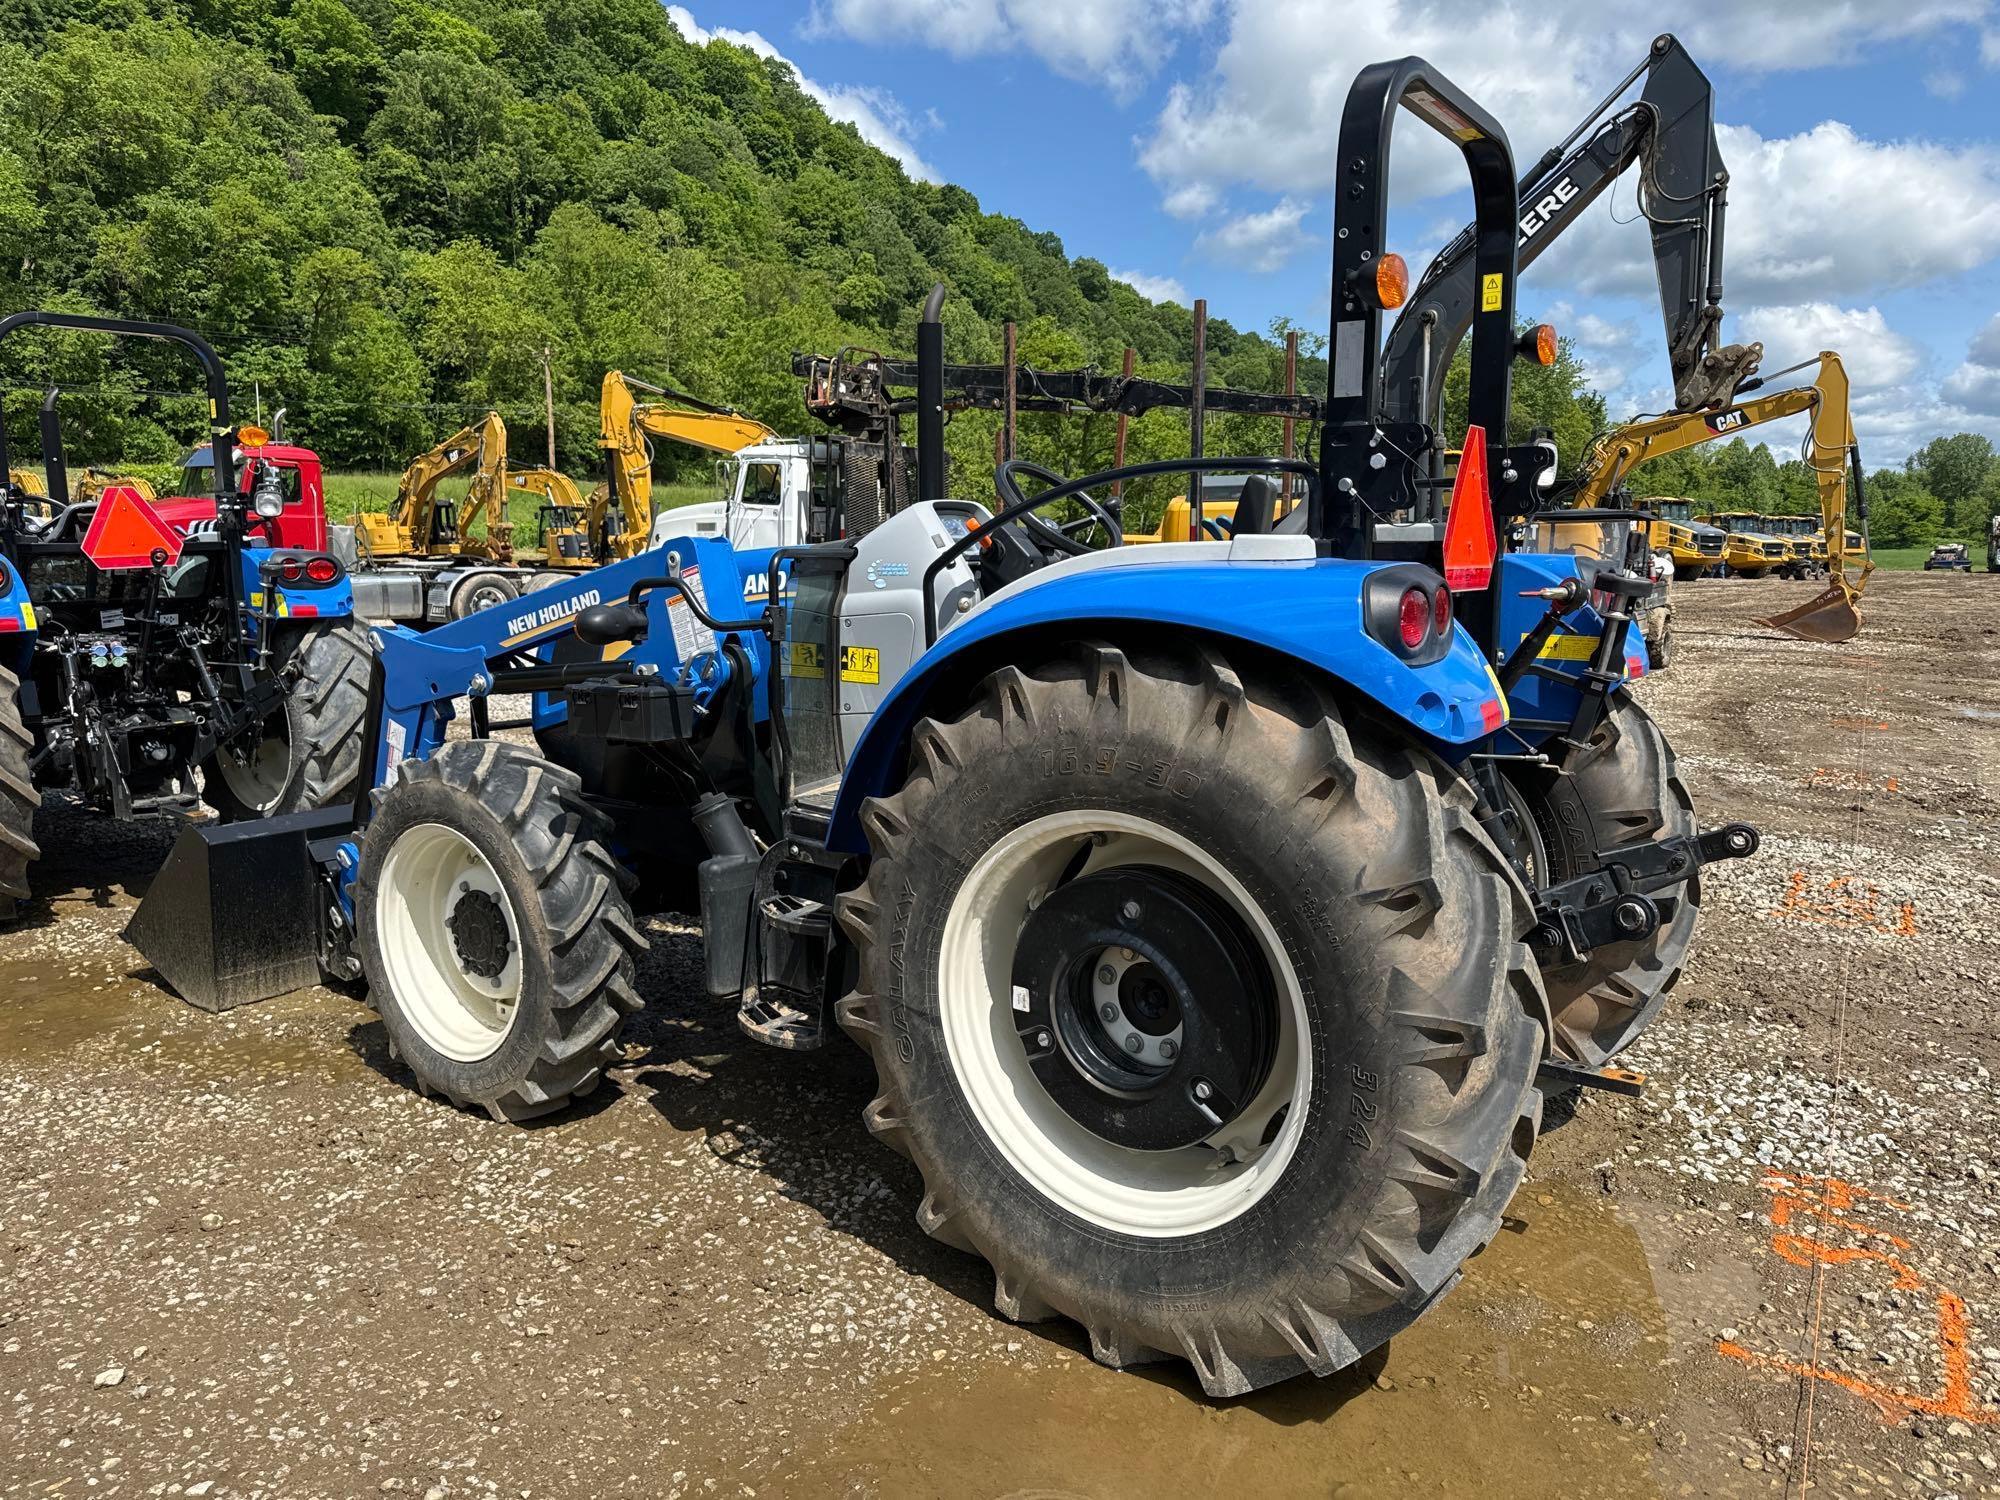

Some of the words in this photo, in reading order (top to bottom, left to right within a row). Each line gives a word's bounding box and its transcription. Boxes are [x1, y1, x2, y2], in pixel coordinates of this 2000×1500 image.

[1518, 176, 1580, 248] ERE
[1715, 410, 1742, 432] CAT
[507, 611, 538, 636] NEW
[538, 589, 601, 625] HOLLAND
[889, 875, 917, 1063] GALAXY
[1348, 1063, 1379, 1150] 324
